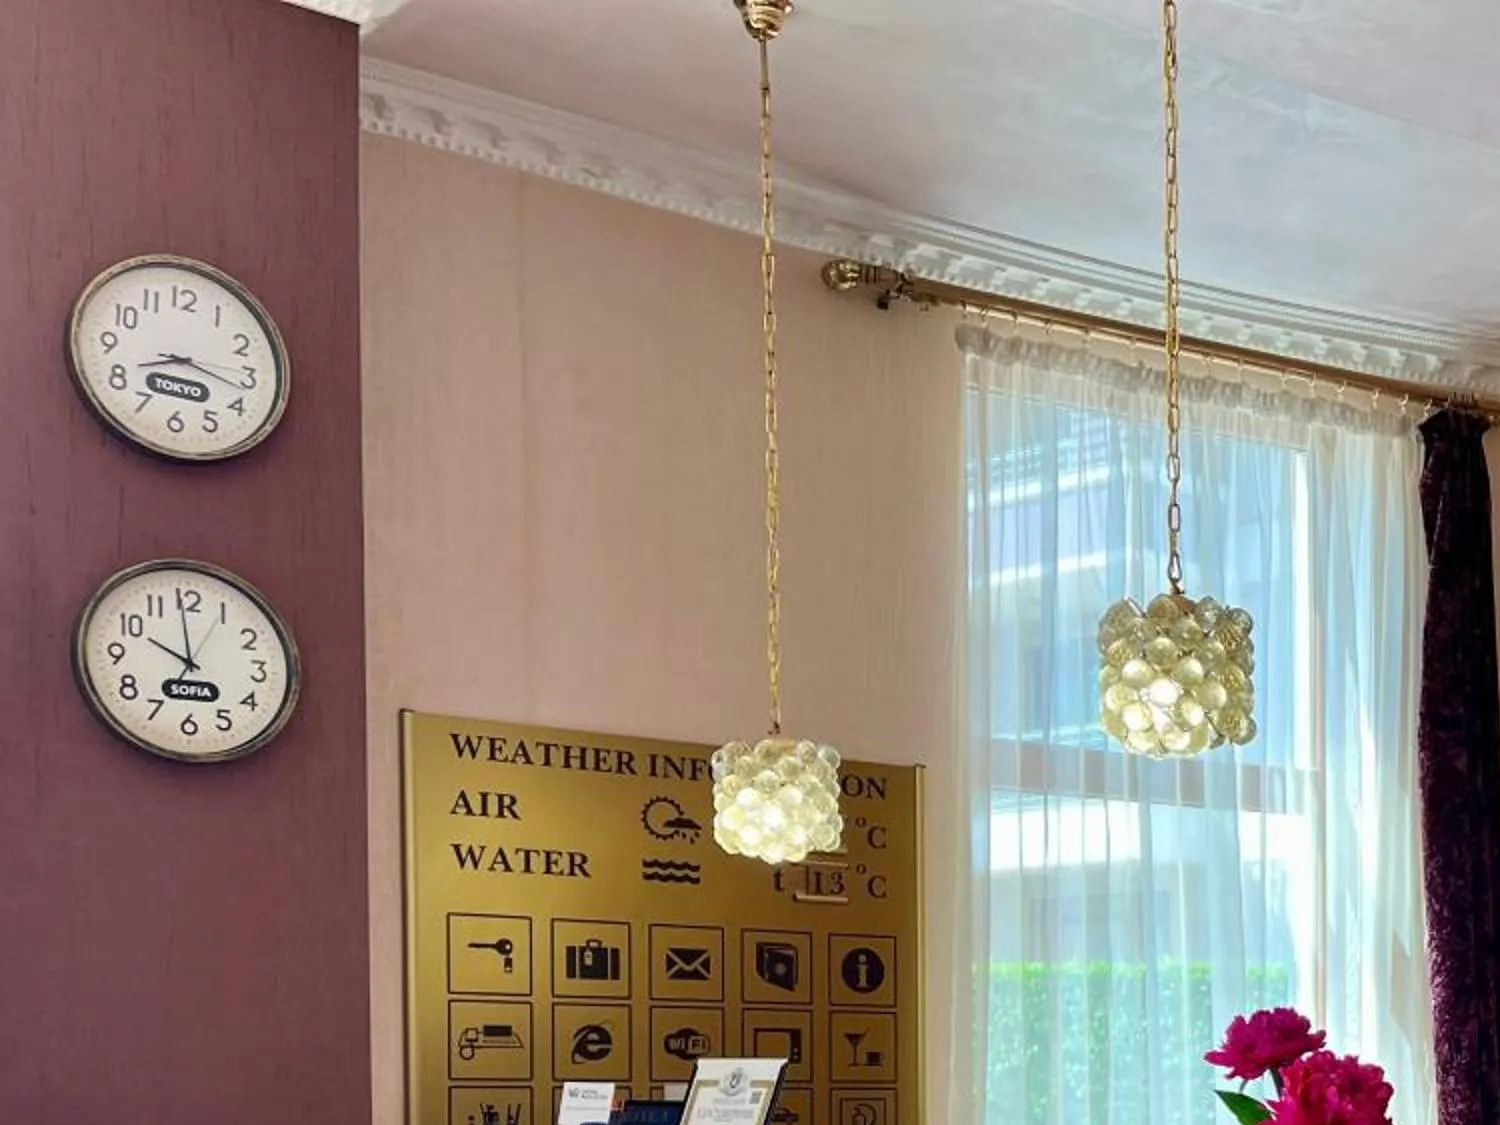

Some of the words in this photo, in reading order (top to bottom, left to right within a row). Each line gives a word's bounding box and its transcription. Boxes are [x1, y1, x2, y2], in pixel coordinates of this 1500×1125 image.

[143, 288, 159, 314] 11
[172, 286, 197, 313] 12
[115, 304, 138, 330] 10
[100, 332, 118, 354] 9
[233, 333, 250, 357] 2
[108, 364, 128, 391] 8
[154, 378, 201, 397] TOKYO
[240, 366, 257, 390] 3
[135, 391, 152, 413] 7
[226, 397, 246, 416] 4
[167, 411, 185, 433] 6
[202, 411, 219, 433] 5
[147, 594, 163, 618] 11
[176, 588, 201, 613] 12
[120, 613, 143, 637] 10
[240, 628, 257, 650] 2
[108, 642, 125, 665] 9
[250, 660, 267, 682] 3
[119, 675, 138, 700] 8
[170, 685, 212, 698] SOFIA
[147, 699, 164, 720] 7
[240, 691, 258, 711] 4
[180, 714, 198, 735] 6
[215, 709, 232, 731] 5
[449, 732, 637, 776] WEATHER
[449, 789, 521, 821] AIR
[450, 843, 592, 878] WATER
